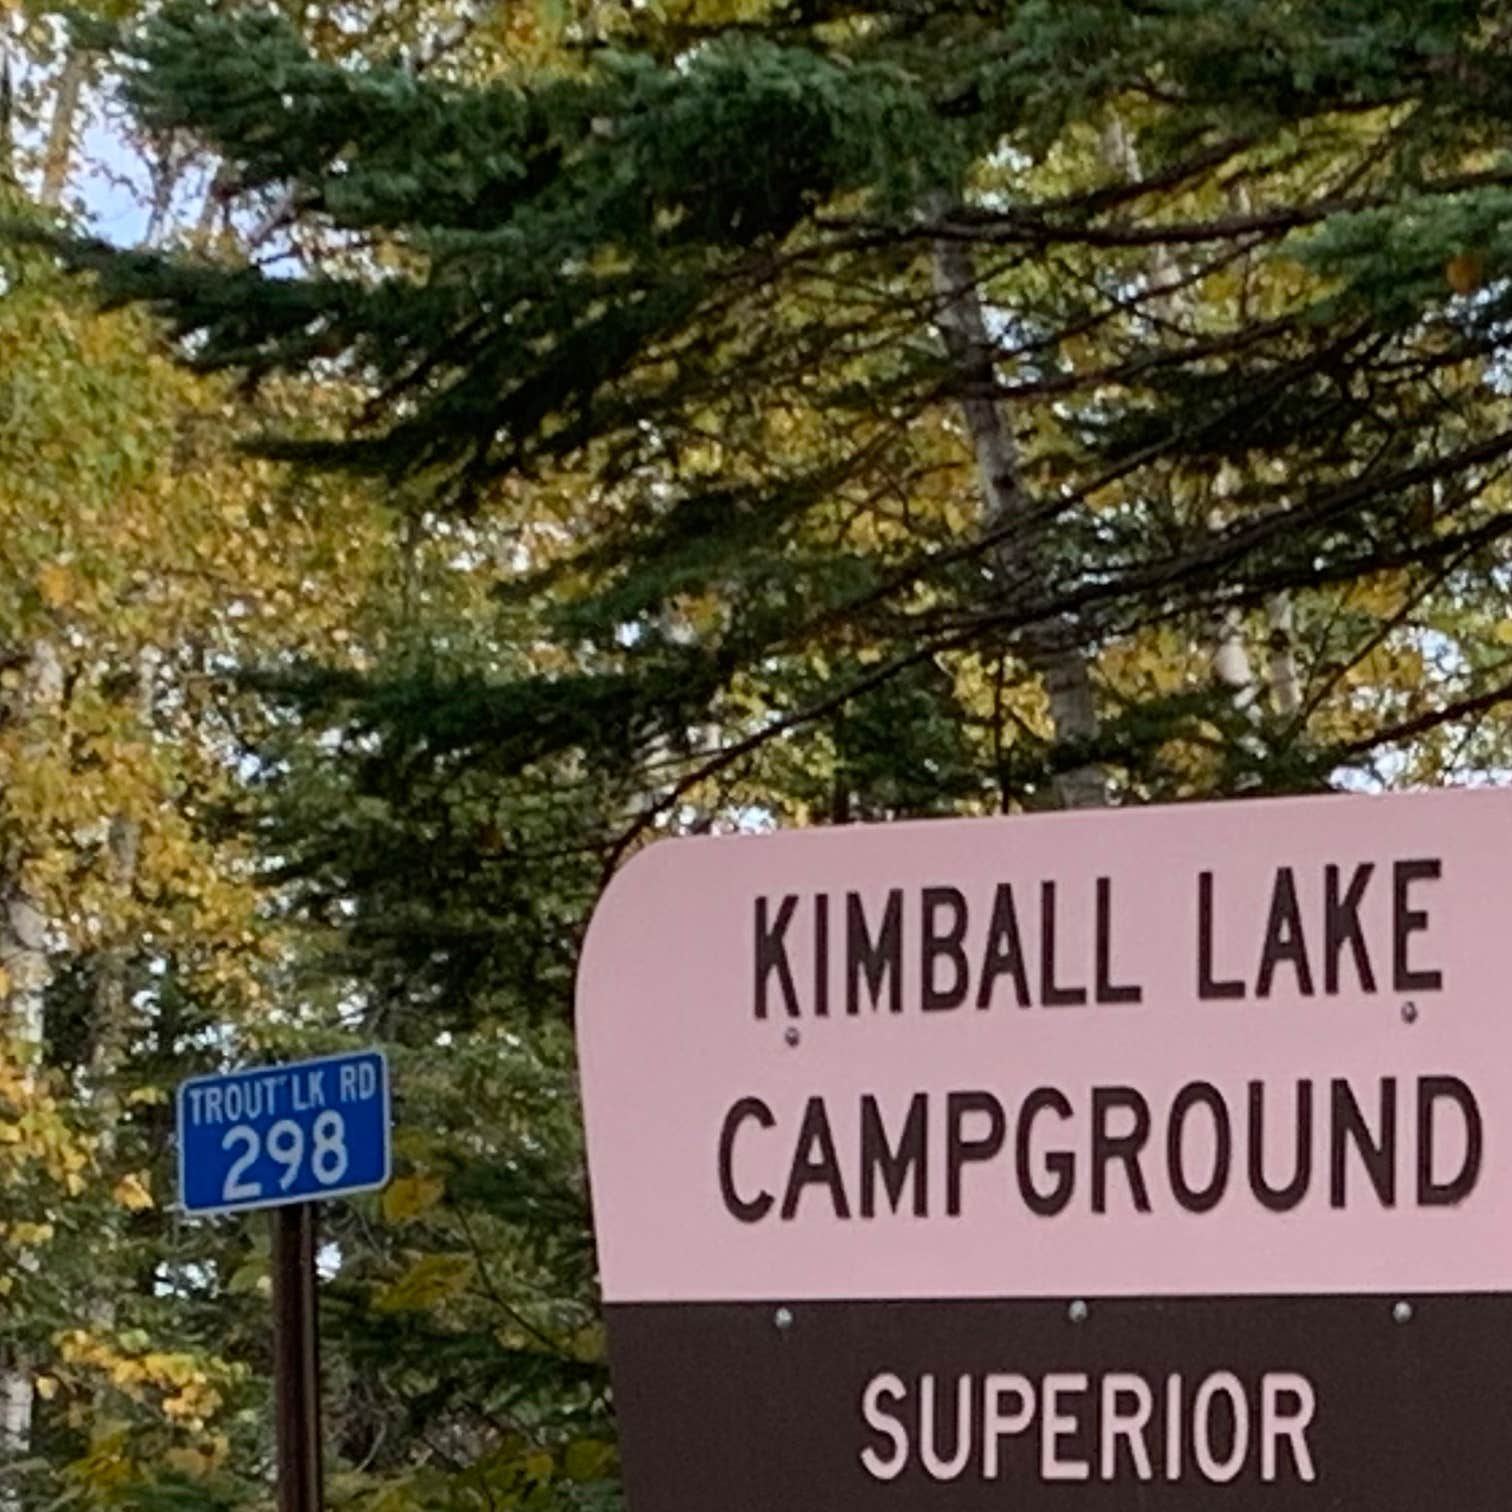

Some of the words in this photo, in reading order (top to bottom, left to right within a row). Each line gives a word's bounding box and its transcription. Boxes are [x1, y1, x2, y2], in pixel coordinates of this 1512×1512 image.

[753, 876, 1143, 1021] KIMBALL
[1196, 858, 1443, 1001] LAKE
[189, 1075, 280, 1126] TROUT
[291, 1069, 326, 1111] LK
[340, 1061, 377, 1102] RD
[717, 1074, 1484, 1224] CAMPGROUND
[221, 1109, 348, 1201] 298
[860, 1370, 1316, 1483] SUPERIOR
